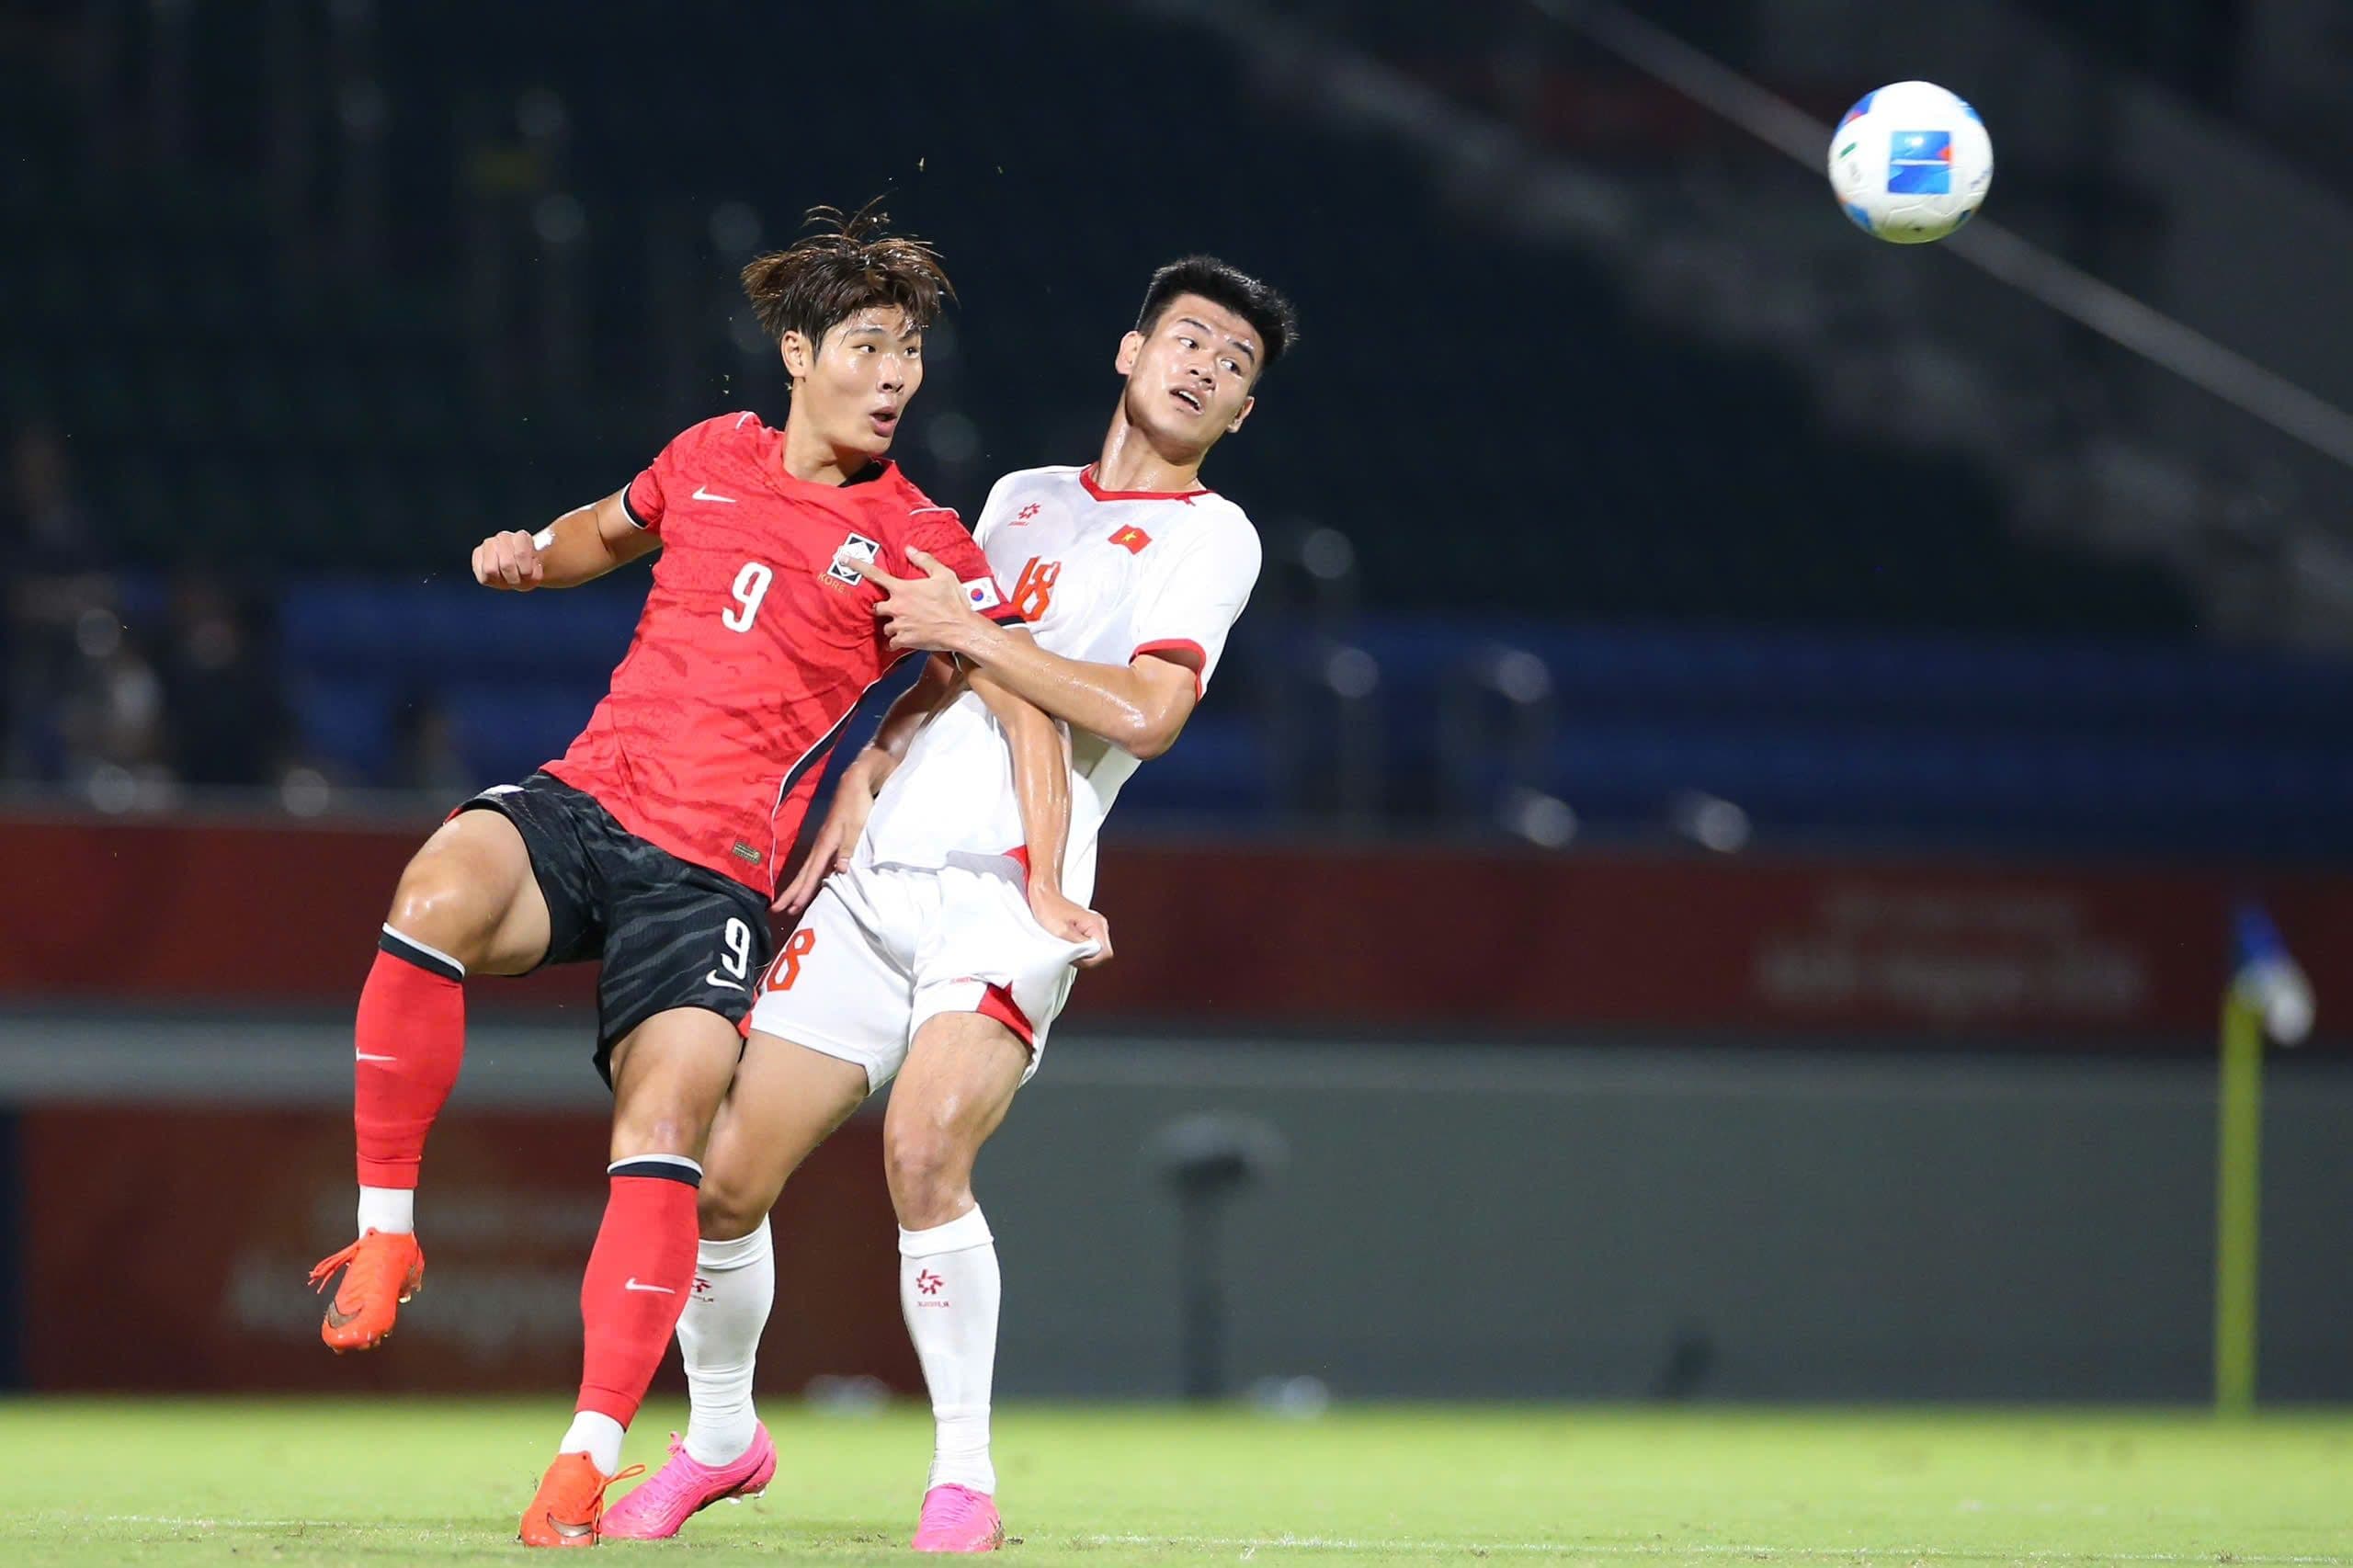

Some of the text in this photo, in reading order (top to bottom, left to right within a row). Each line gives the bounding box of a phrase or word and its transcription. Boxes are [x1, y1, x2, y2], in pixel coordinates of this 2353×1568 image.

[721, 562, 773, 633] 9
[1011, 555, 1061, 621] 18
[720, 917, 750, 980] 9
